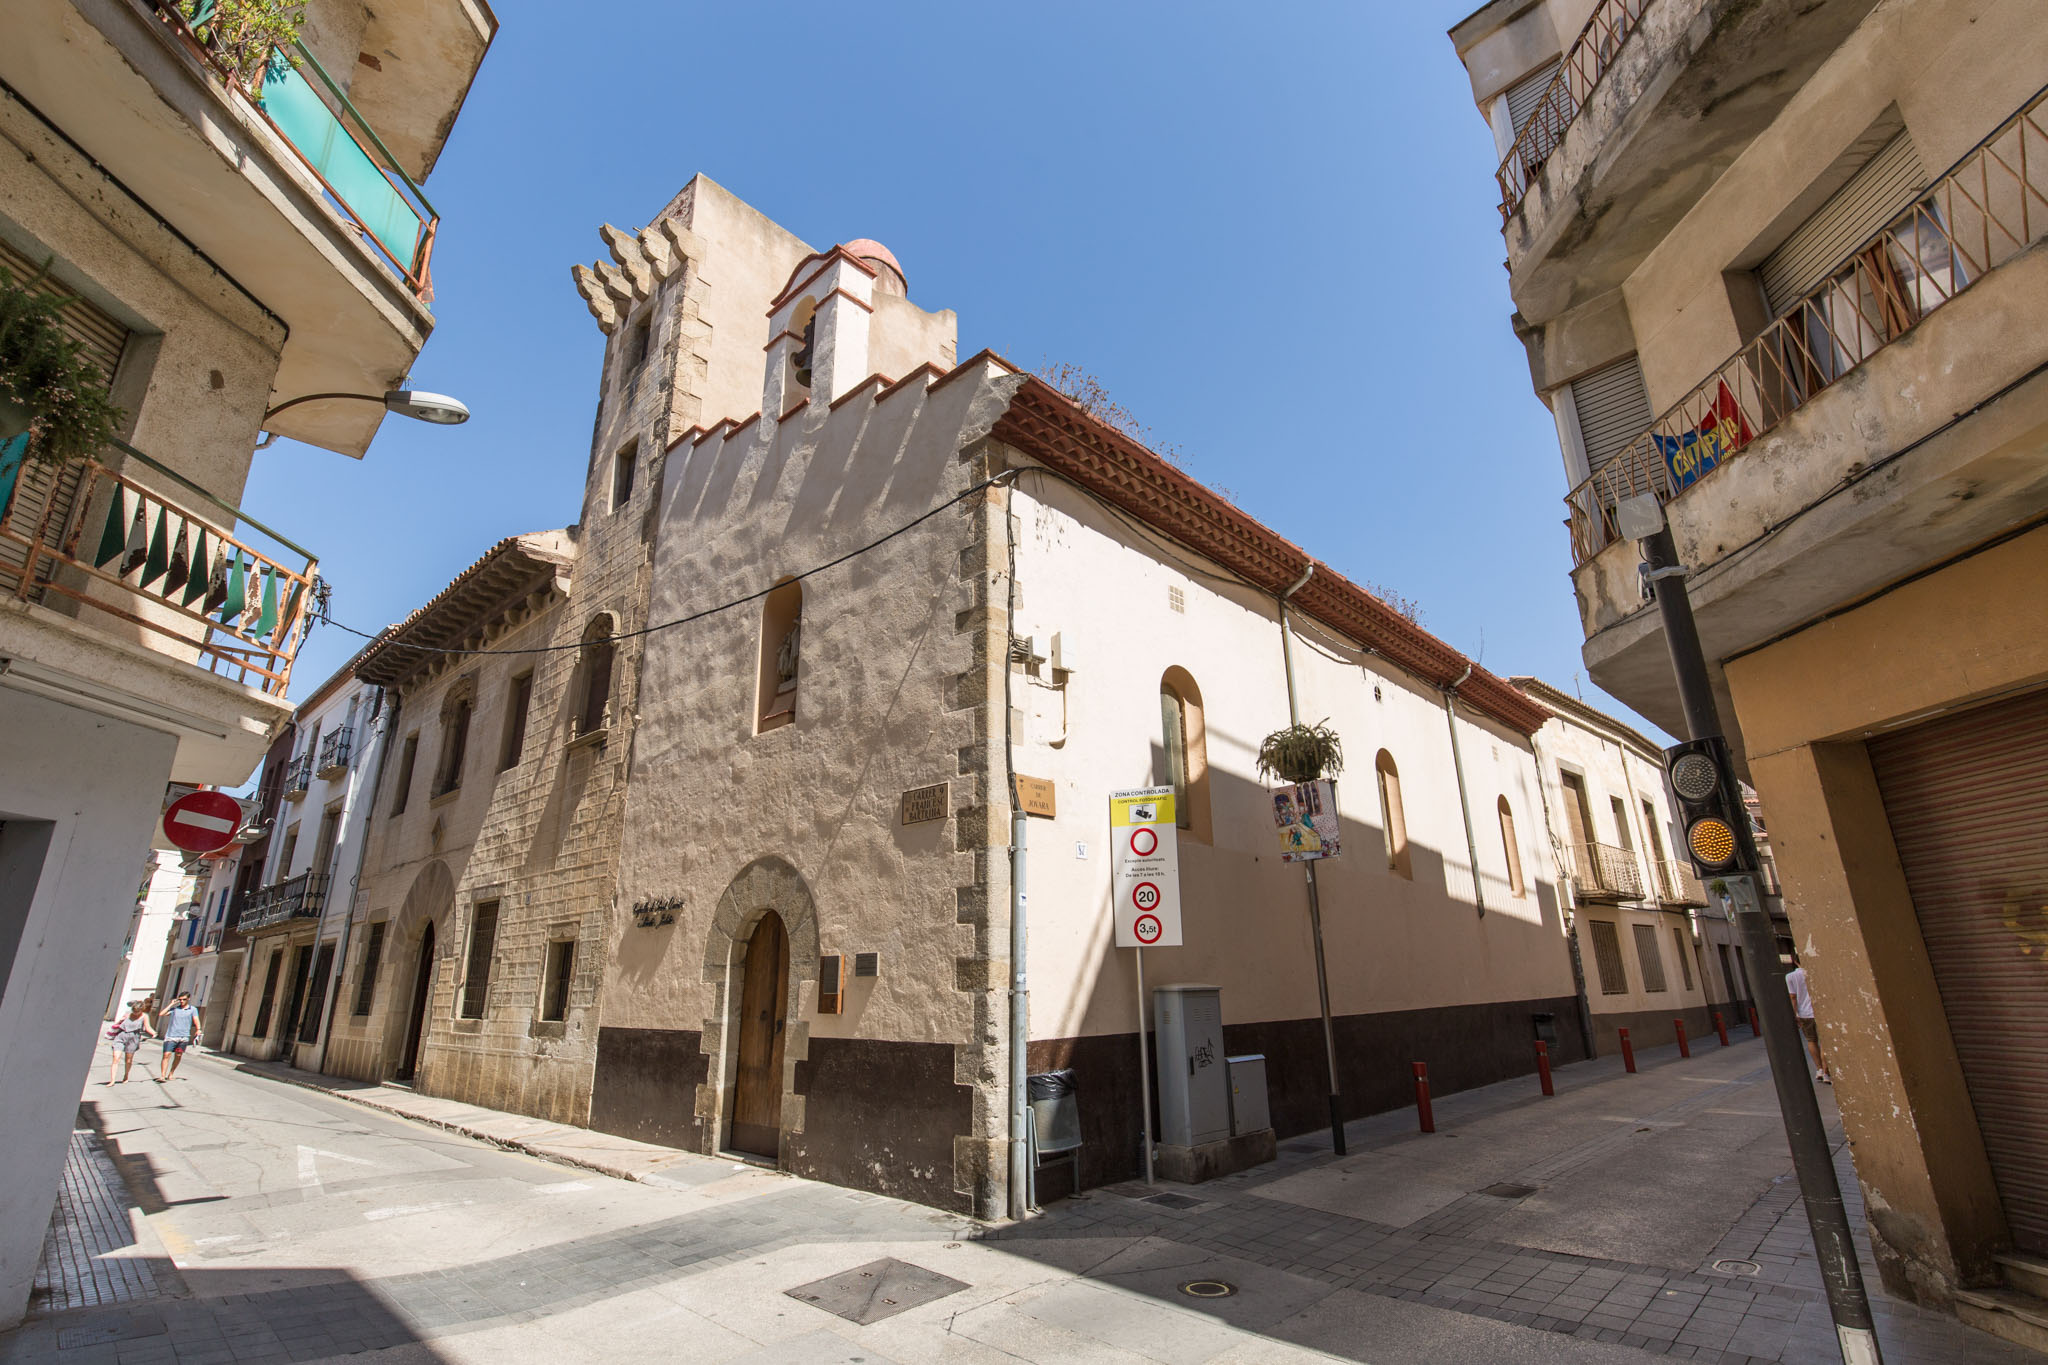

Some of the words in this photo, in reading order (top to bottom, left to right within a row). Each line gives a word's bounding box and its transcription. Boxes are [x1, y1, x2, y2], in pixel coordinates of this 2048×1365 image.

[913, 788, 936, 800] CARRER
[1131, 788, 1169, 796] CONTROLADA
[1138, 891, 1154, 903] 20
[1139, 924, 1156, 934] 3,5t
